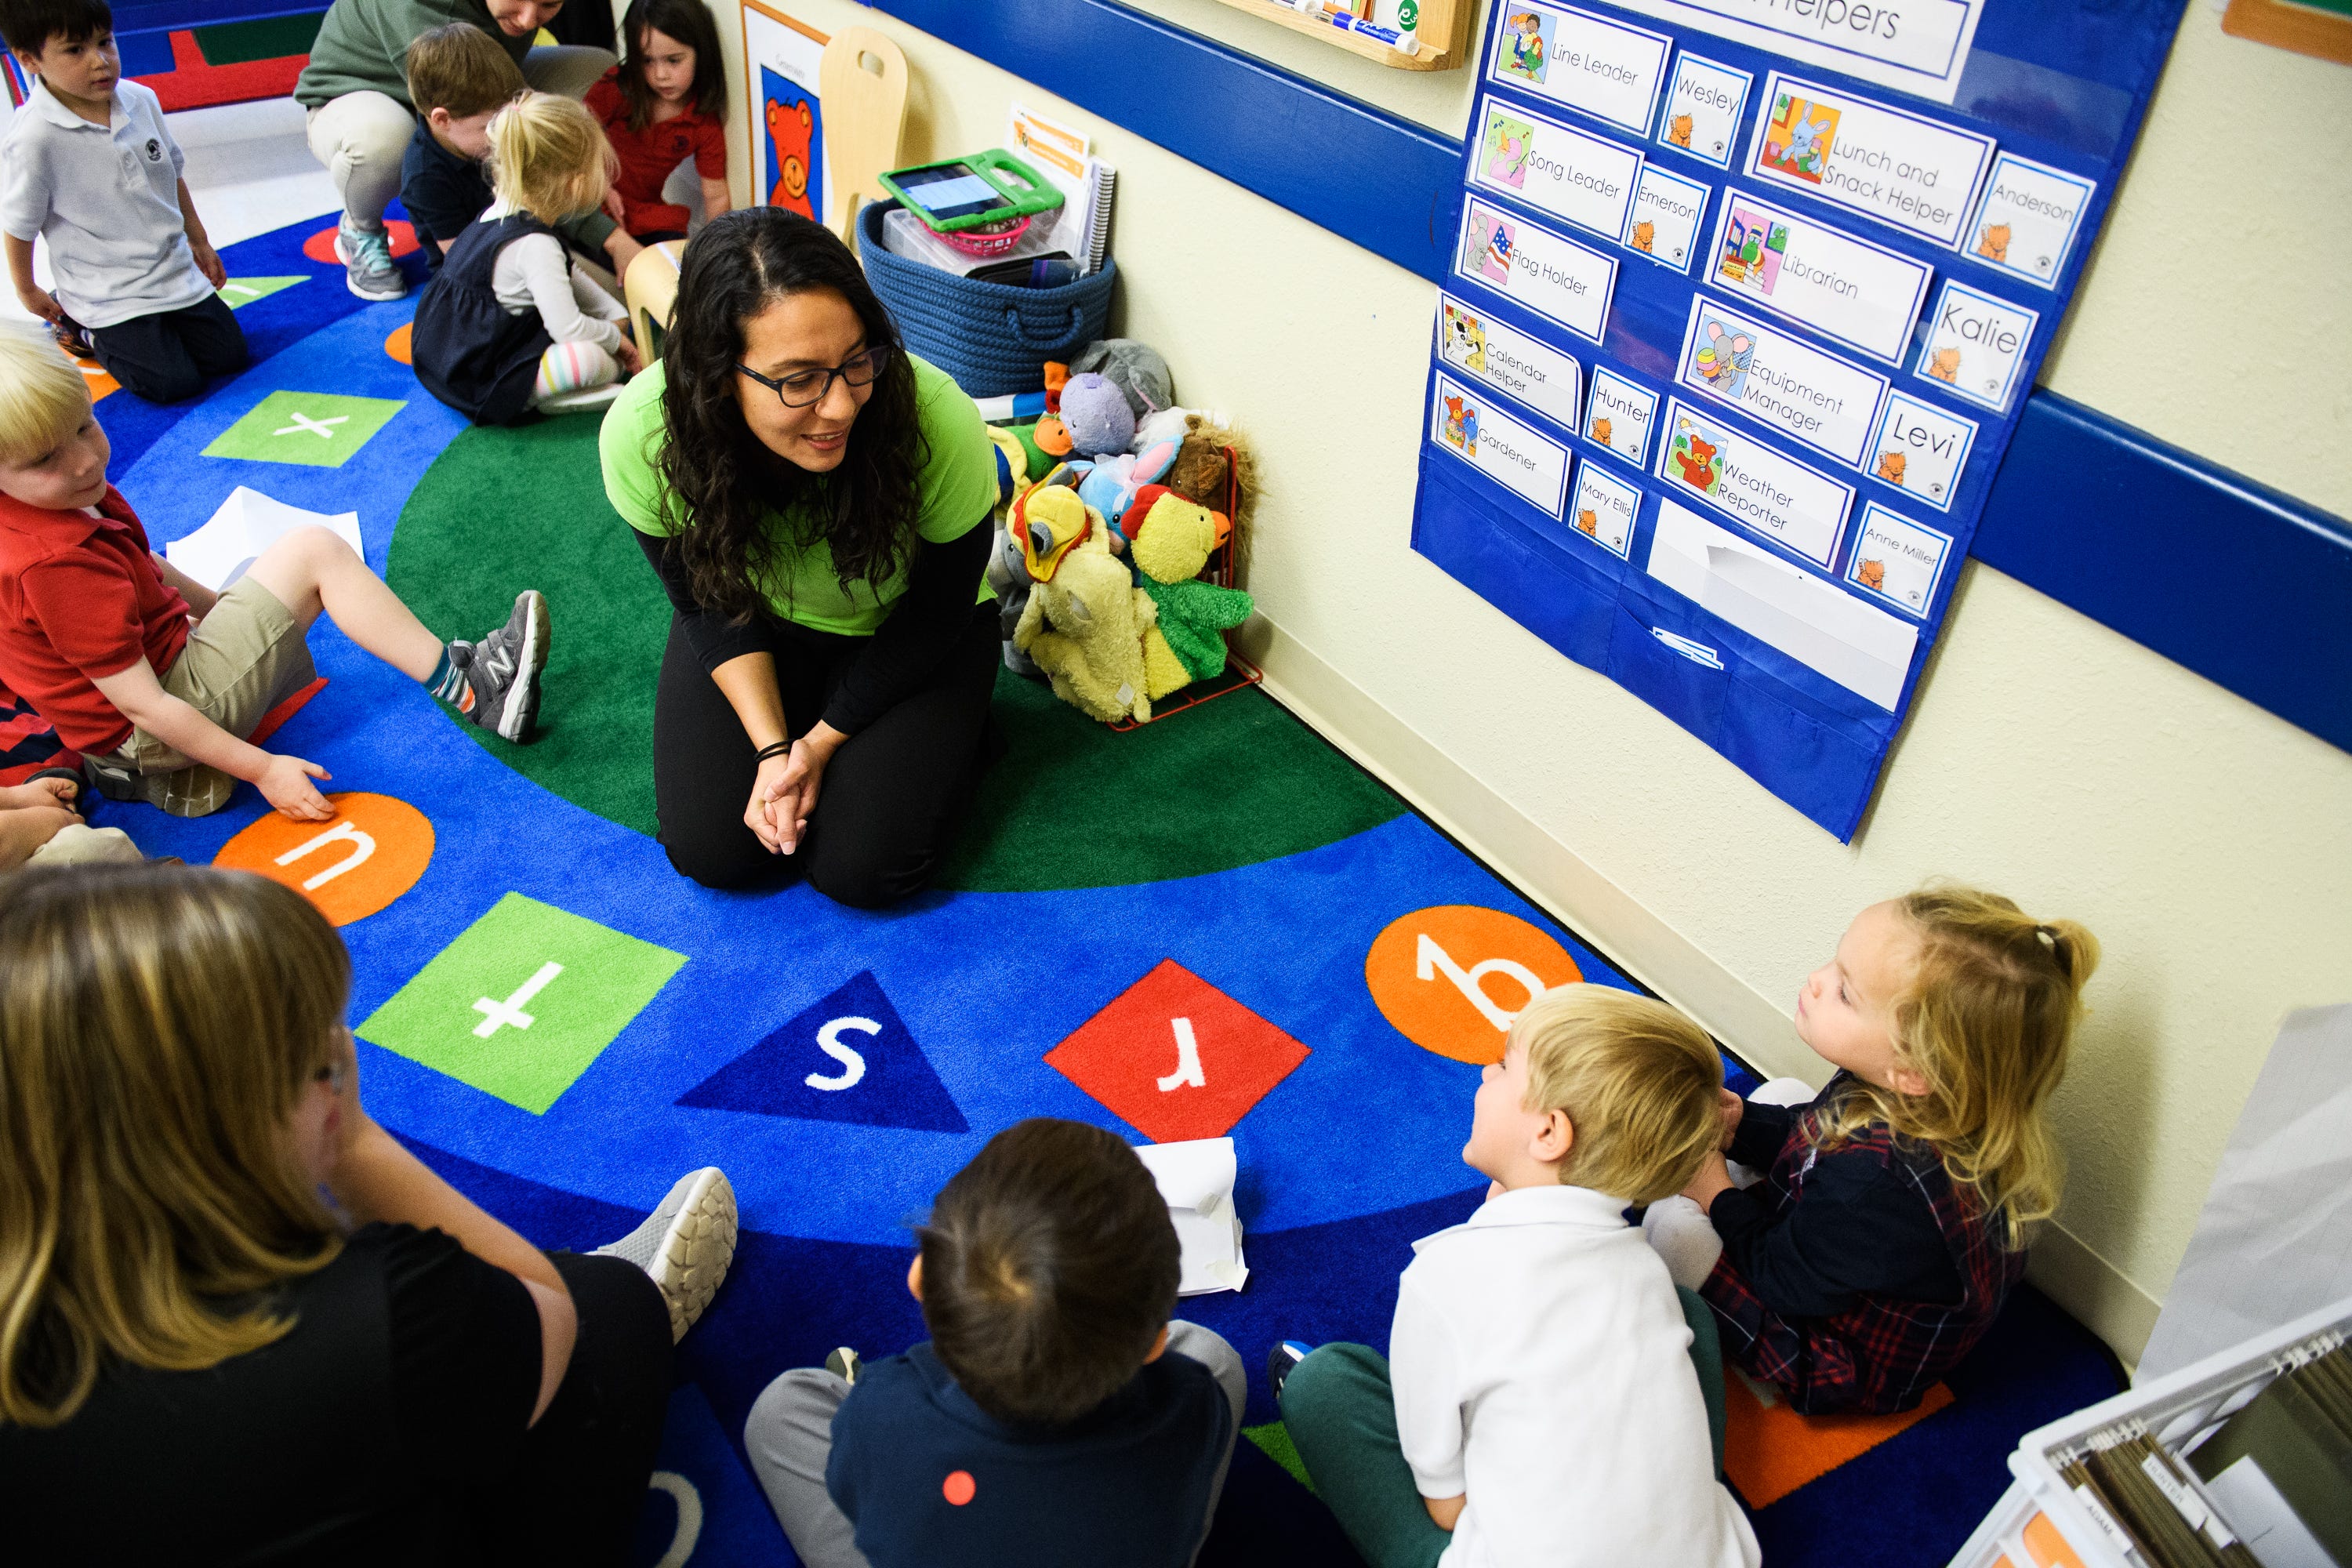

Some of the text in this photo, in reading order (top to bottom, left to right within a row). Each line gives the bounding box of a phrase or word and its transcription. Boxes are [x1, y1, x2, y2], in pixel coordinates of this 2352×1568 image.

[1552, 42, 1638, 86] Line Leader
[1678, 75, 1740, 116] Wesley
[1529, 151, 1621, 200] Song Leader
[1832, 136, 1939, 188] Lunch and
[1639, 187, 1697, 222] Emerson
[1824, 165, 1953, 225] Snack Helper
[1992, 184, 2074, 223] Anderson
[1512, 249, 1588, 296] Flag Holder
[1782, 252, 1859, 299] Librarian
[1940, 303, 2017, 354] Kalie
[1486, 343, 1547, 383] Calendar
[1486, 362, 1526, 394] Helper
[1595, 385, 1650, 424] Hunter
[1743, 384, 1824, 434] Manager
[1751, 358, 1844, 415] Equipment
[1479, 428, 1537, 472] Gardener
[1893, 414, 1957, 459] Levi
[1581, 481, 1632, 517] Mary Ellis
[1718, 483, 1788, 531] Reporter
[1724, 460, 1794, 509] Weather
[1865, 528, 1938, 566] Anne Miller
[804, 1016, 882, 1091] s
